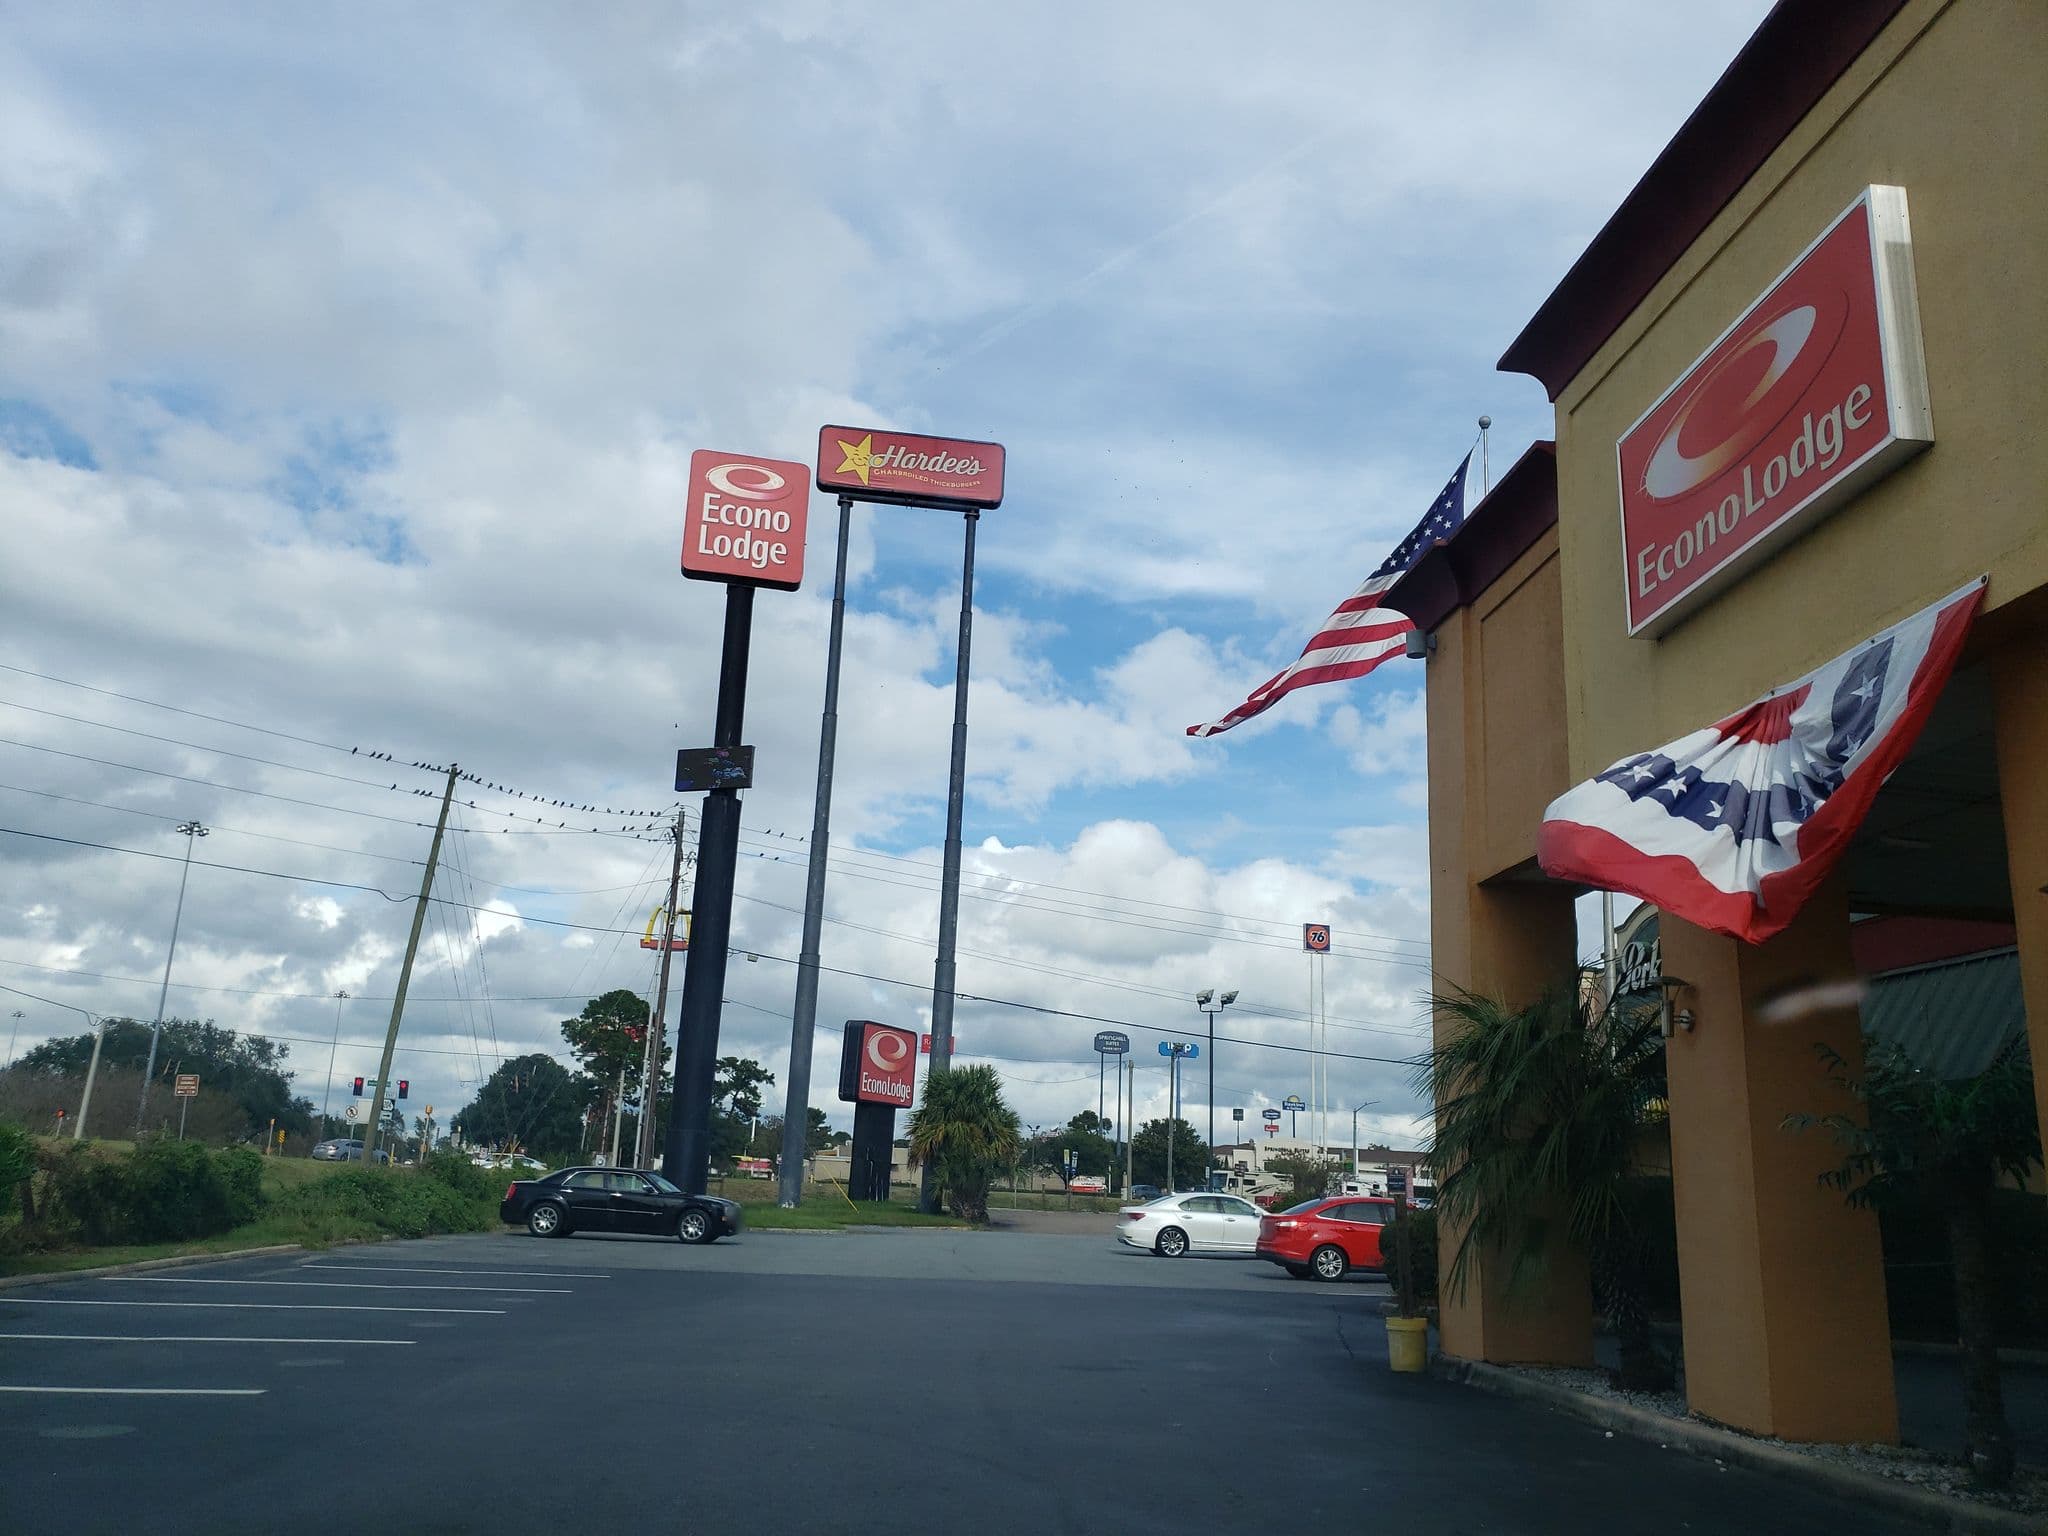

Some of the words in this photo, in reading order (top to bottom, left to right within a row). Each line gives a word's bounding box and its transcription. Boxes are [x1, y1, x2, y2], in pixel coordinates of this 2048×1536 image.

[868, 445, 987, 476] Hardee's
[873, 468, 929, 482] CHARBROILED
[1637, 383, 1872, 599] EconoLodge
[702, 492, 791, 533] Econo
[698, 524, 788, 569] Lodge
[1311, 931, 1325, 943] 76
[861, 1071, 911, 1102] EconoLodge
